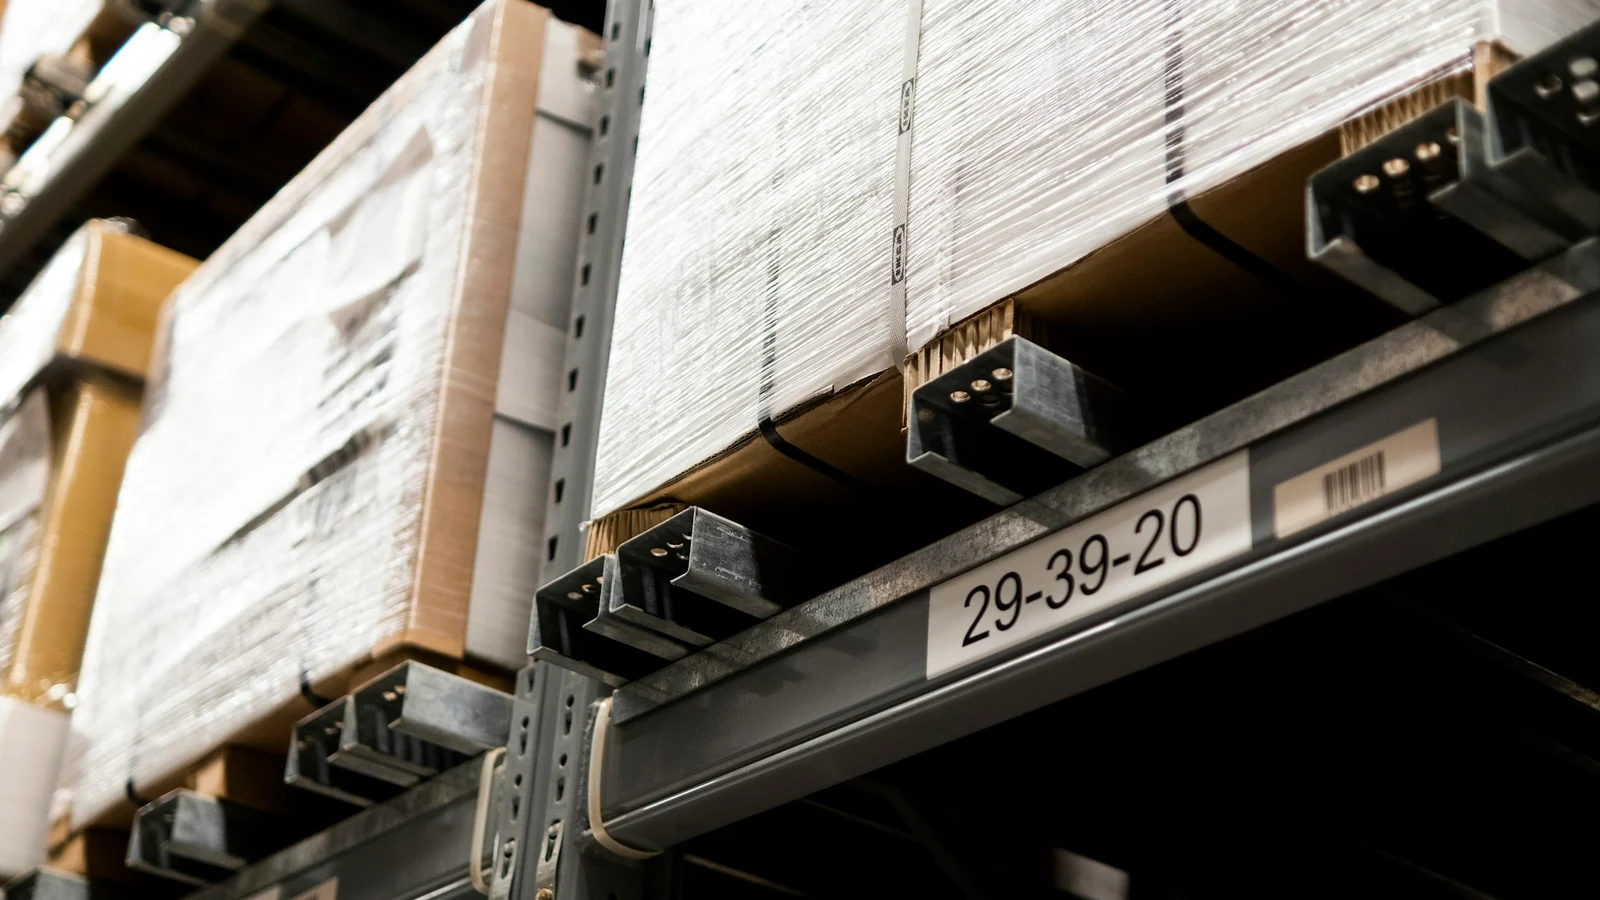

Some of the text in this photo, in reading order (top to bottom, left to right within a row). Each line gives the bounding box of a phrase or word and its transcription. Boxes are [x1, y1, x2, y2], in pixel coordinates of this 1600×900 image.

[901, 83, 912, 130] IKEA
[894, 229, 903, 279] IKEA
[962, 493, 1202, 647] 29-39-20
